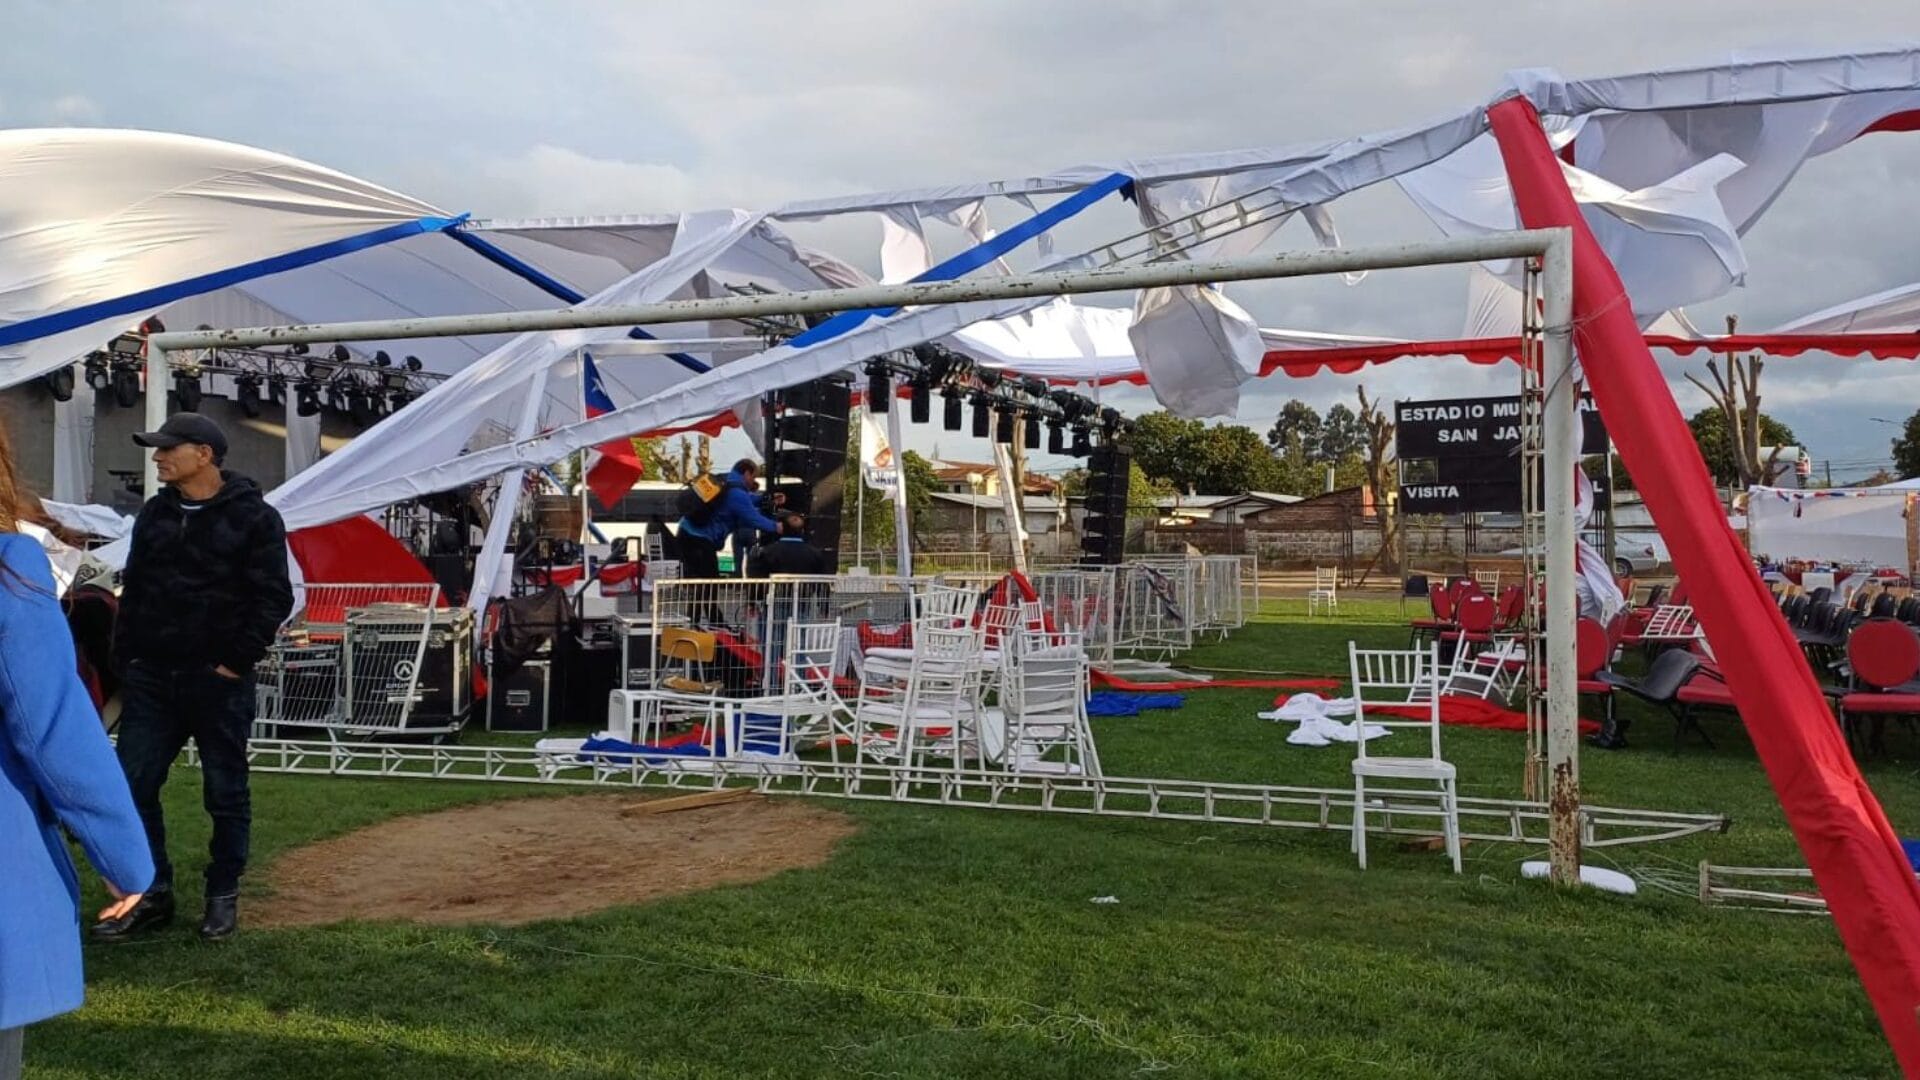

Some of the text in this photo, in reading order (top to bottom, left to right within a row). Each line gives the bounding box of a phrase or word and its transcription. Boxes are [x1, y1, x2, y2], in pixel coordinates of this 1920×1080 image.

[1400, 404, 1485, 422] ESTADIO
[1437, 428, 1478, 442] SAN
[1406, 486, 1459, 498] VISITA
